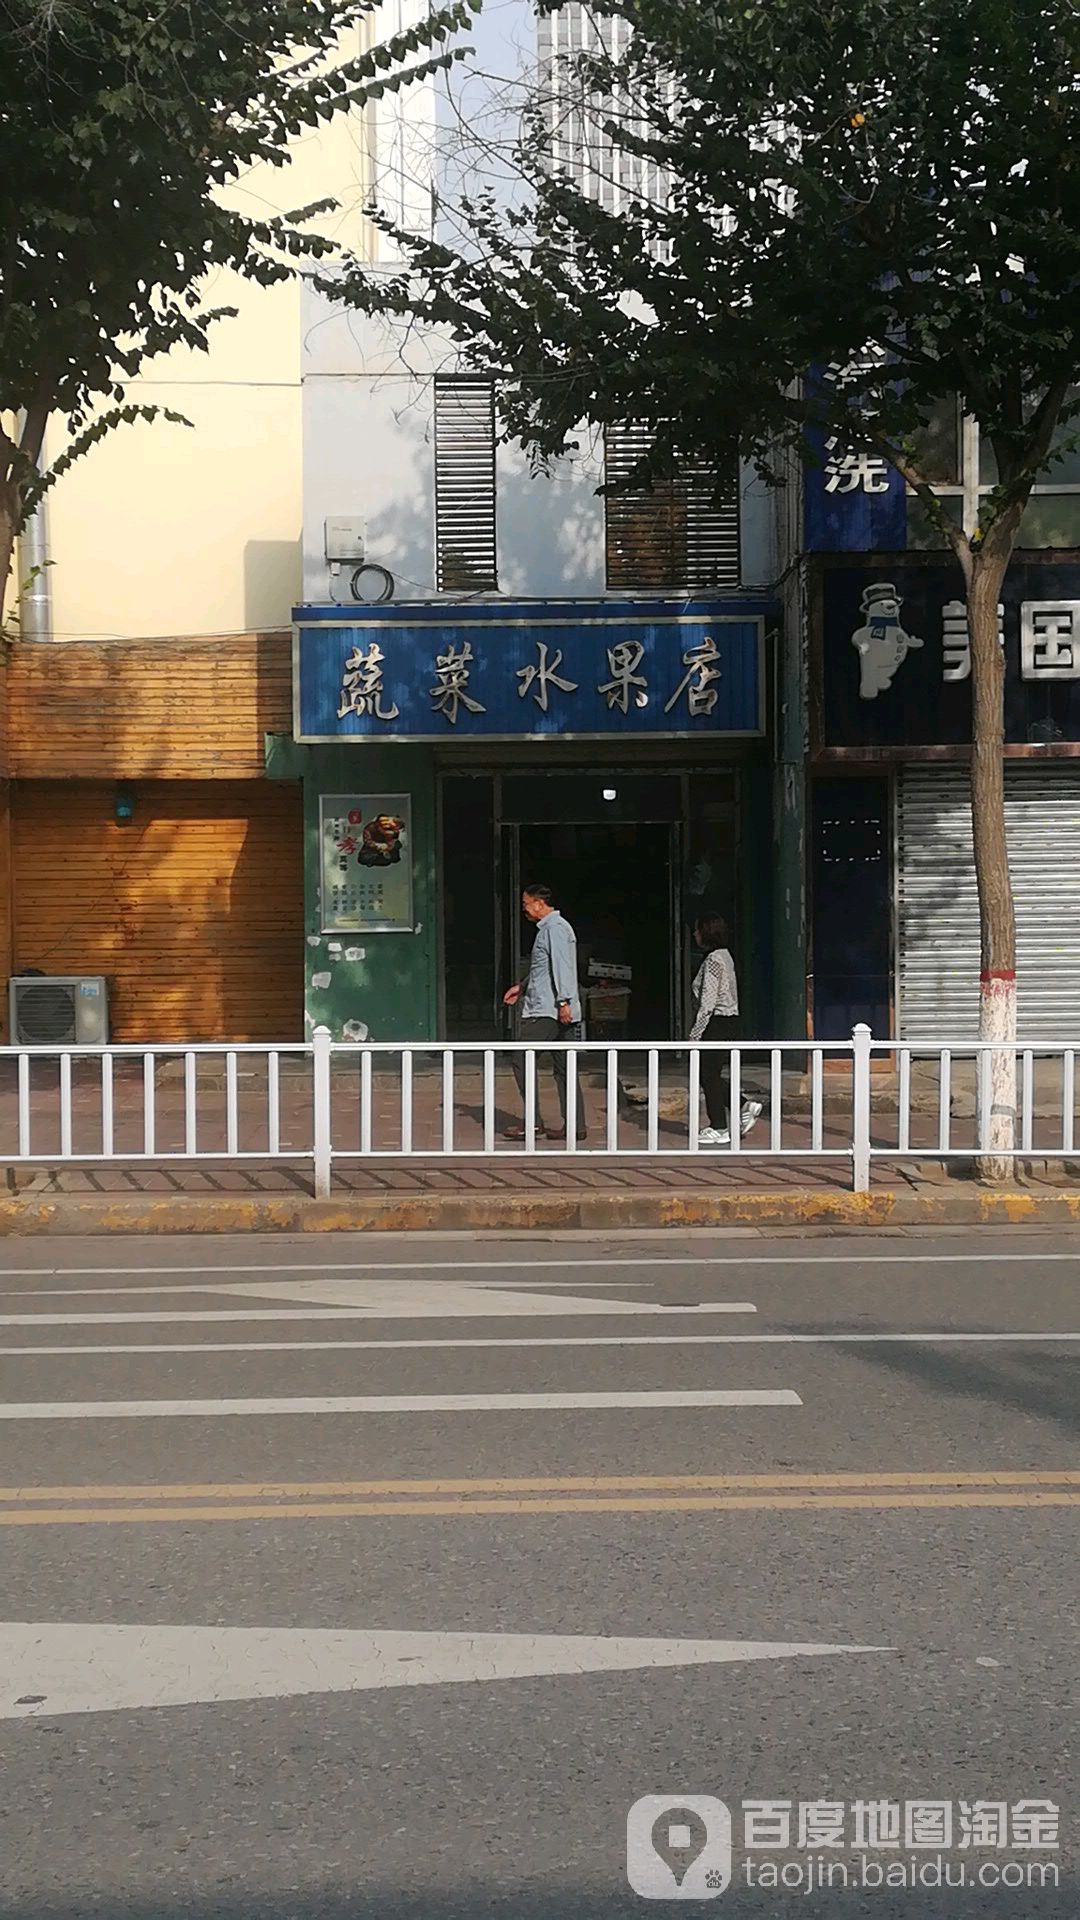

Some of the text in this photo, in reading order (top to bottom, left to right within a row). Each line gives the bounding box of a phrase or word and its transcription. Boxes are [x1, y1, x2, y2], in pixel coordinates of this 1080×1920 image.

[337, 637, 722, 725] 蔬菜水果店
